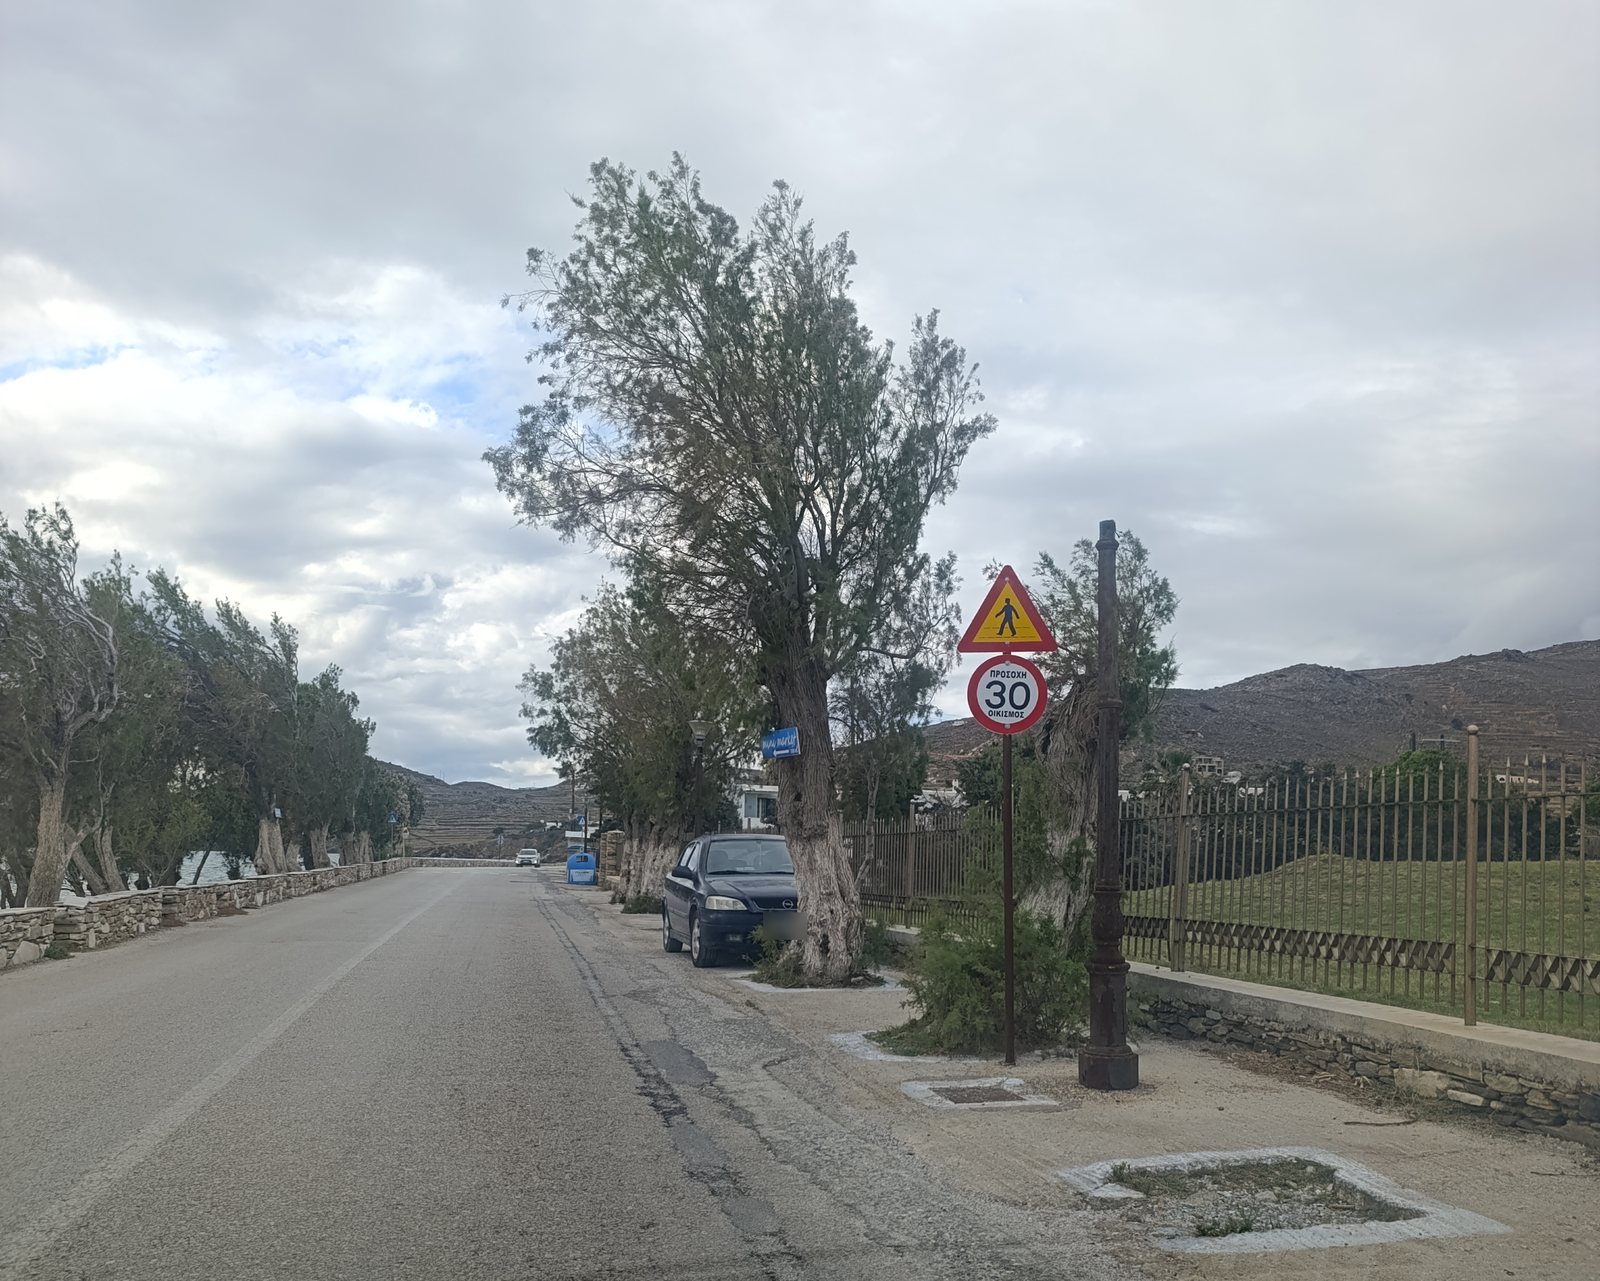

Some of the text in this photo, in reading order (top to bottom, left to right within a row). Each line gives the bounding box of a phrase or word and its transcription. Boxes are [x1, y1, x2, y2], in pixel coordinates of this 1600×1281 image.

[990, 670, 1027, 679] ΠΡΟΣΟΧΗ
[985, 680, 1031, 710] 30
[988, 710, 1025, 718] ΟΙΚΙΣΜΟΣ
